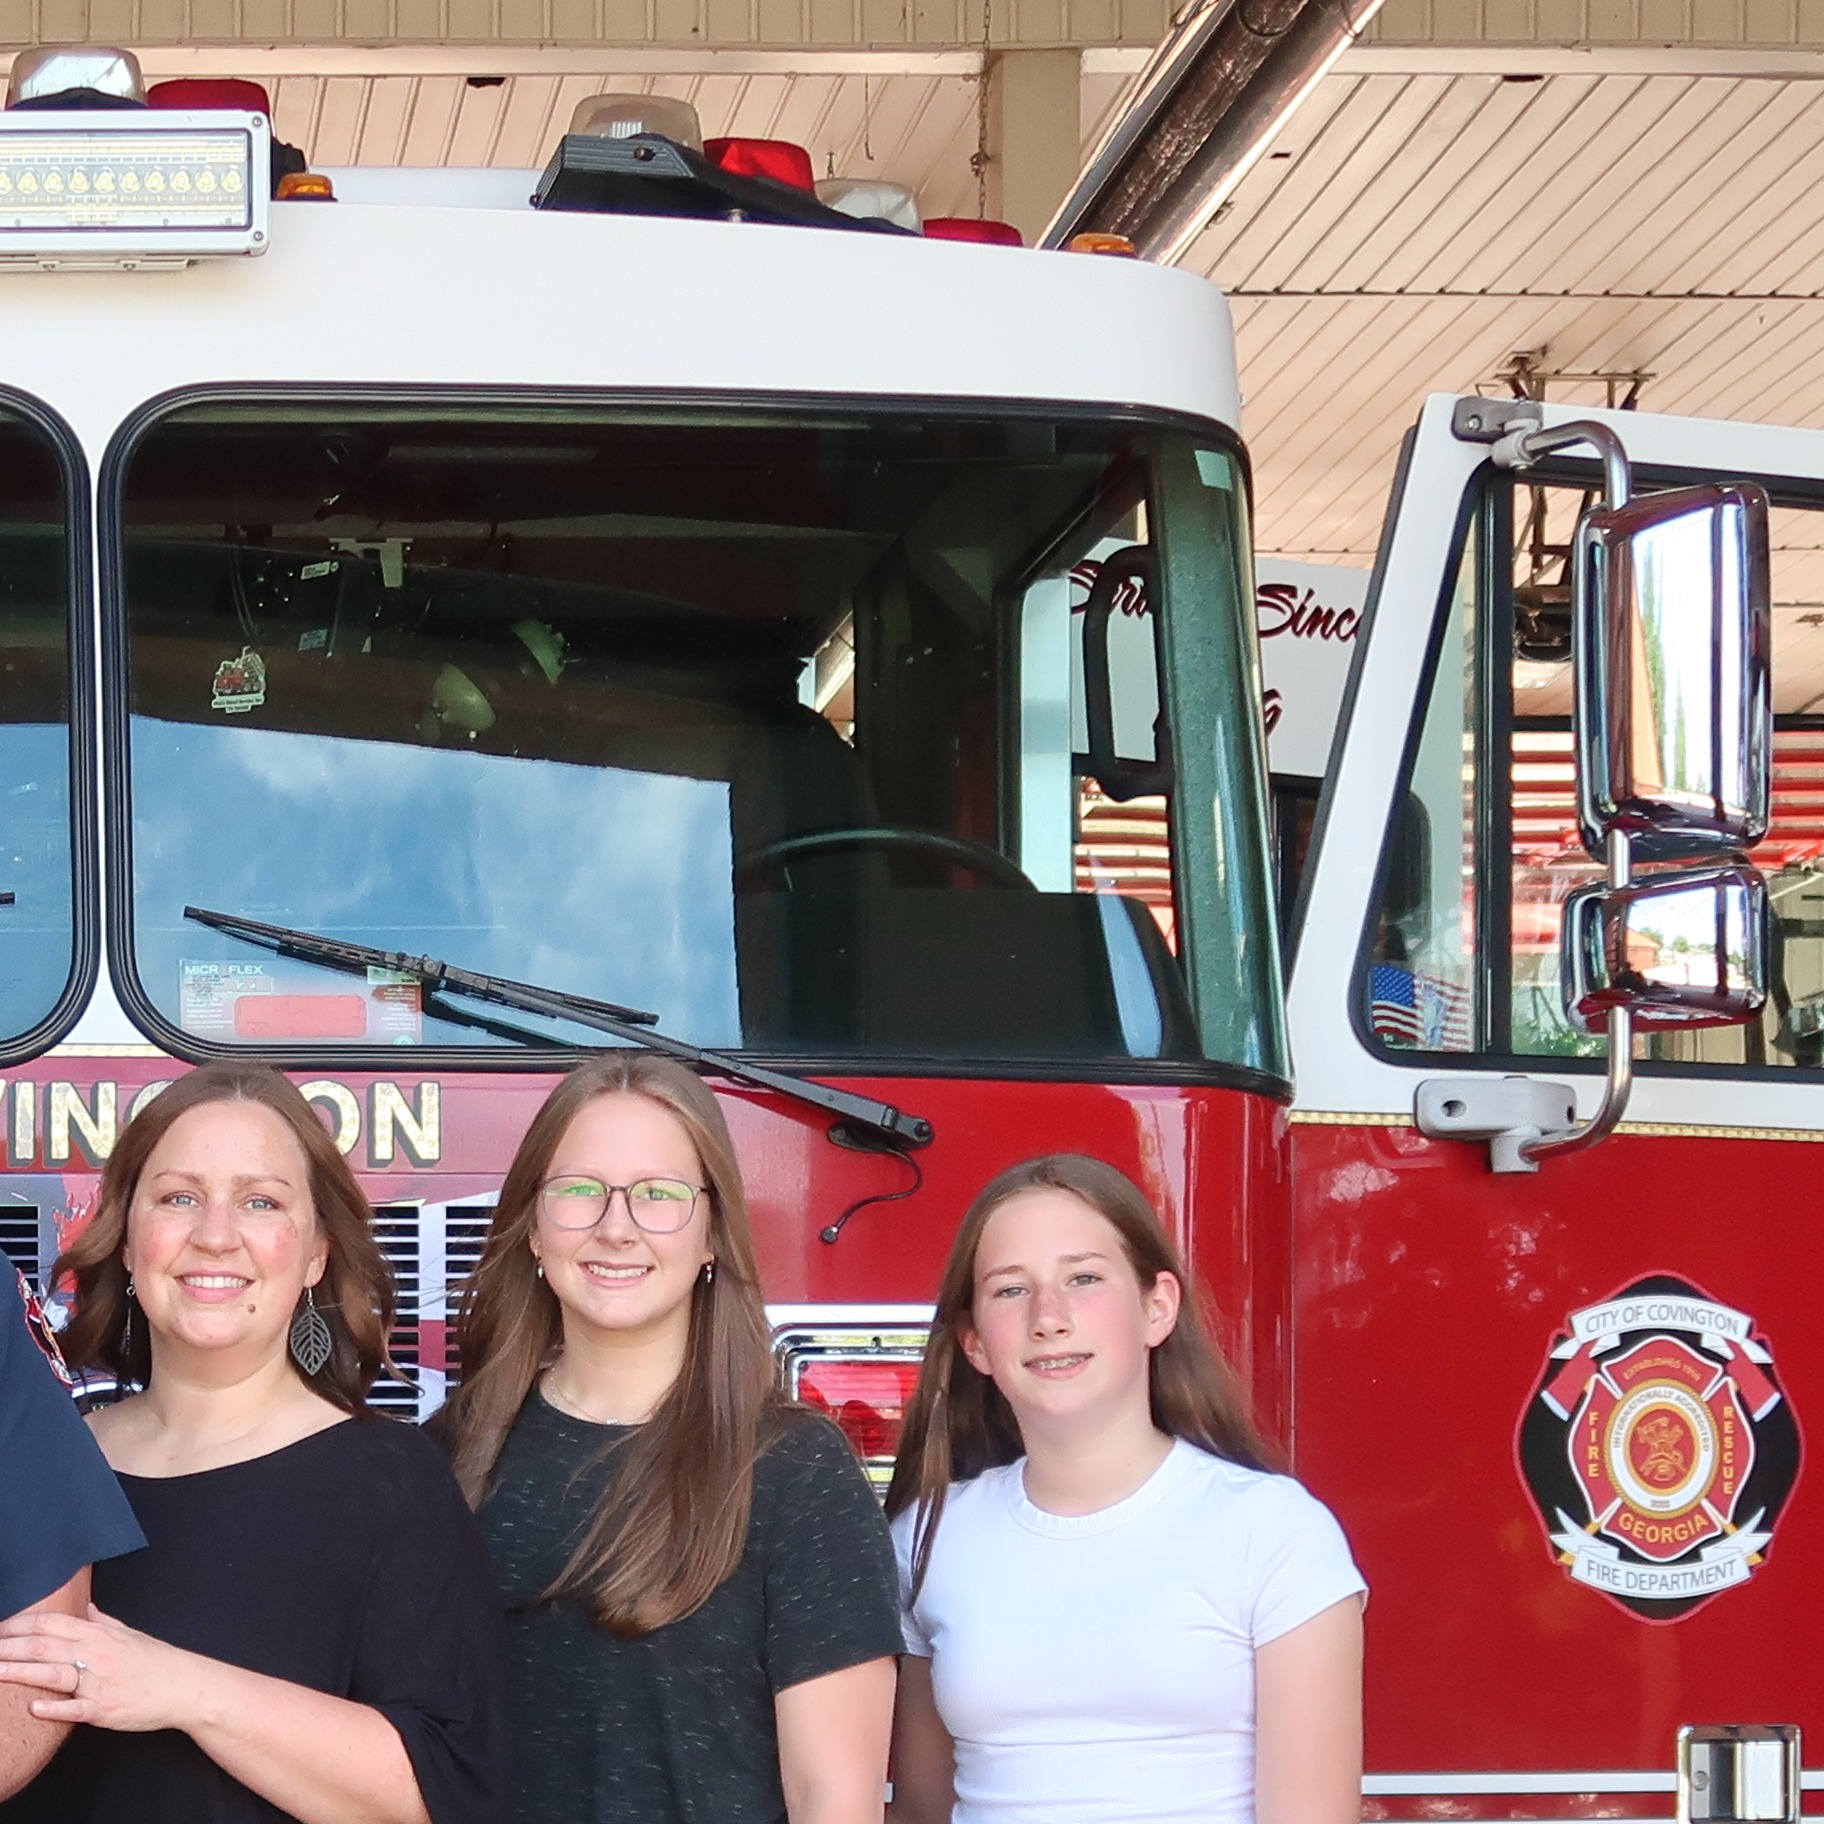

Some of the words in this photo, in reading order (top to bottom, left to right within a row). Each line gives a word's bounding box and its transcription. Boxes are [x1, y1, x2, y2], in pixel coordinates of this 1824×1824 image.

[1256, 582, 1364, 643] Sinc
[1585, 1309, 1620, 1334] CITY
[1622, 1305, 1644, 1324] OF
[1647, 1304, 1739, 1336] COVINGTON
[1587, 1411, 1600, 1478] FIRE
[1722, 1405, 1734, 1495] RESCUE
[1618, 1512, 1709, 1544] GEORGIA
[1587, 1559, 1622, 1587] FIRE
[1625, 1559, 1737, 1592] DEPARTMENT
